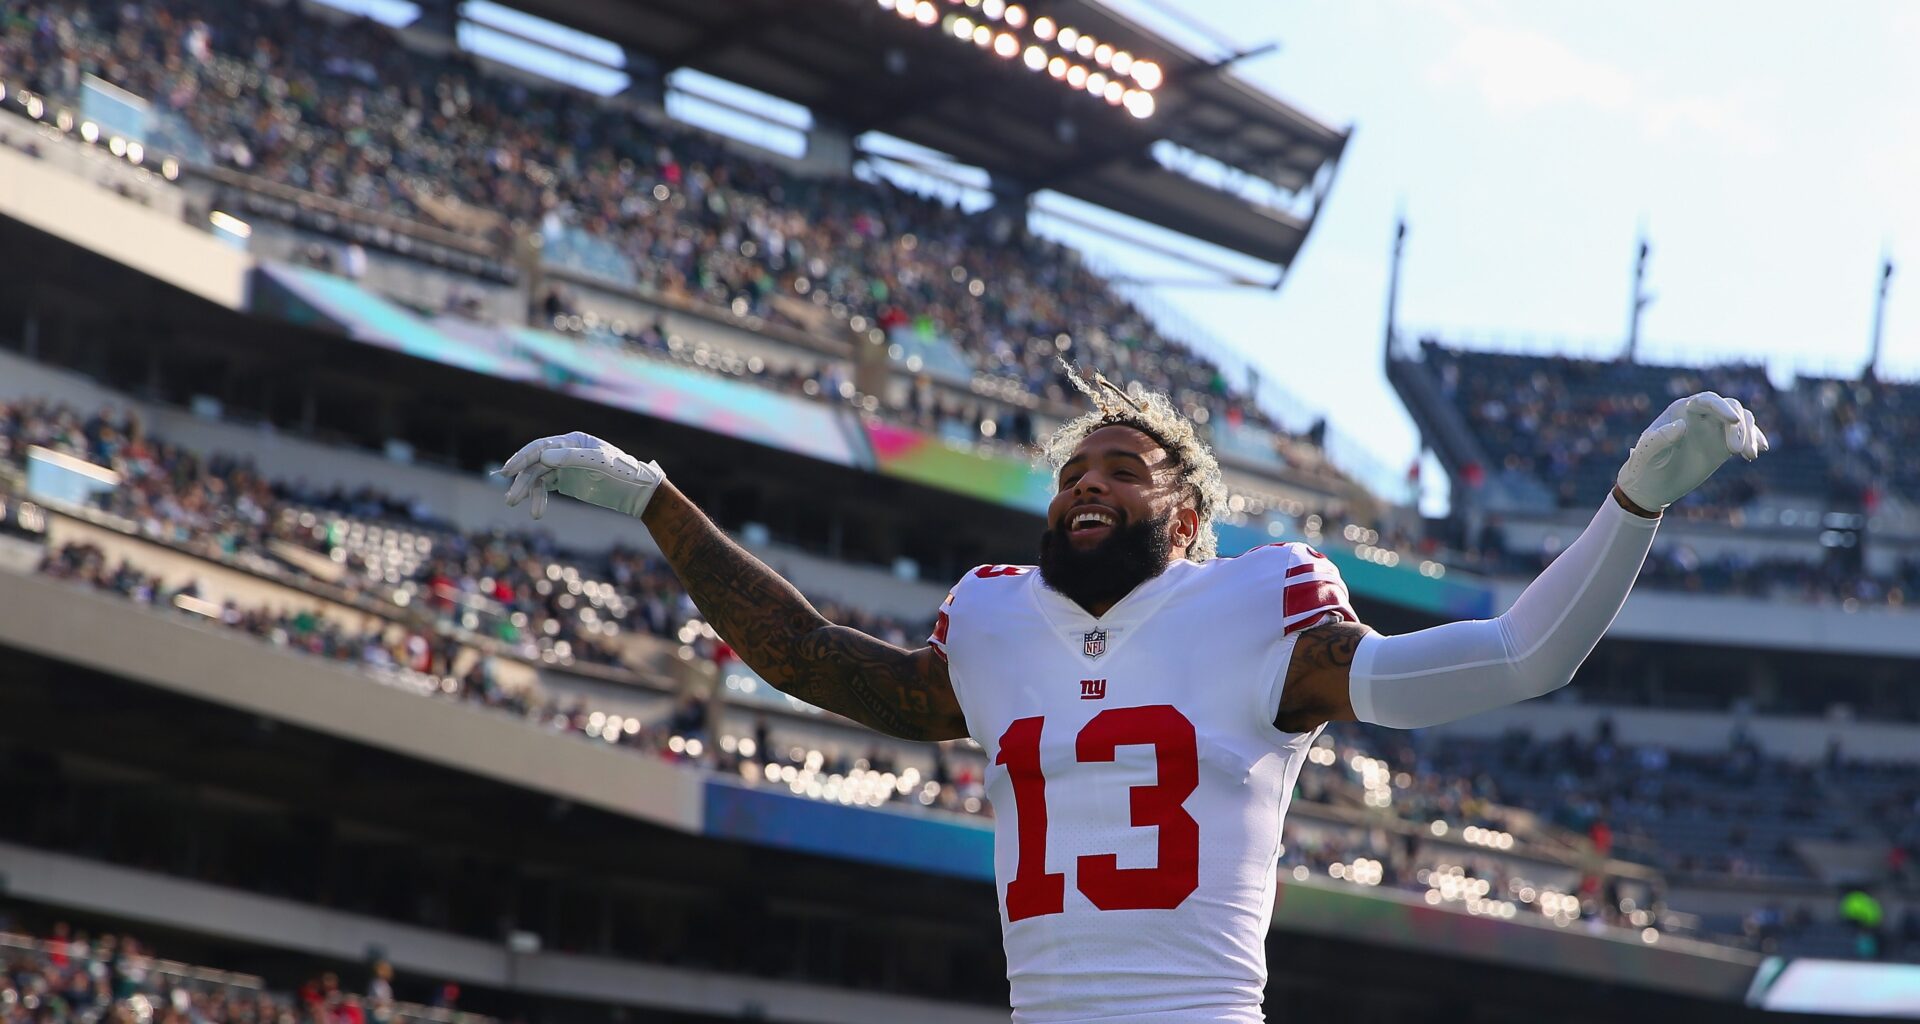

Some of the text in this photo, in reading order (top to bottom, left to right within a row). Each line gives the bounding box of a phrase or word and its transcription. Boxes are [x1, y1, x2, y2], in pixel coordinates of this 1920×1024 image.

[1086, 641, 1103, 654] NFL
[897, 687, 928, 712] 13
[996, 704, 1199, 922] 13
